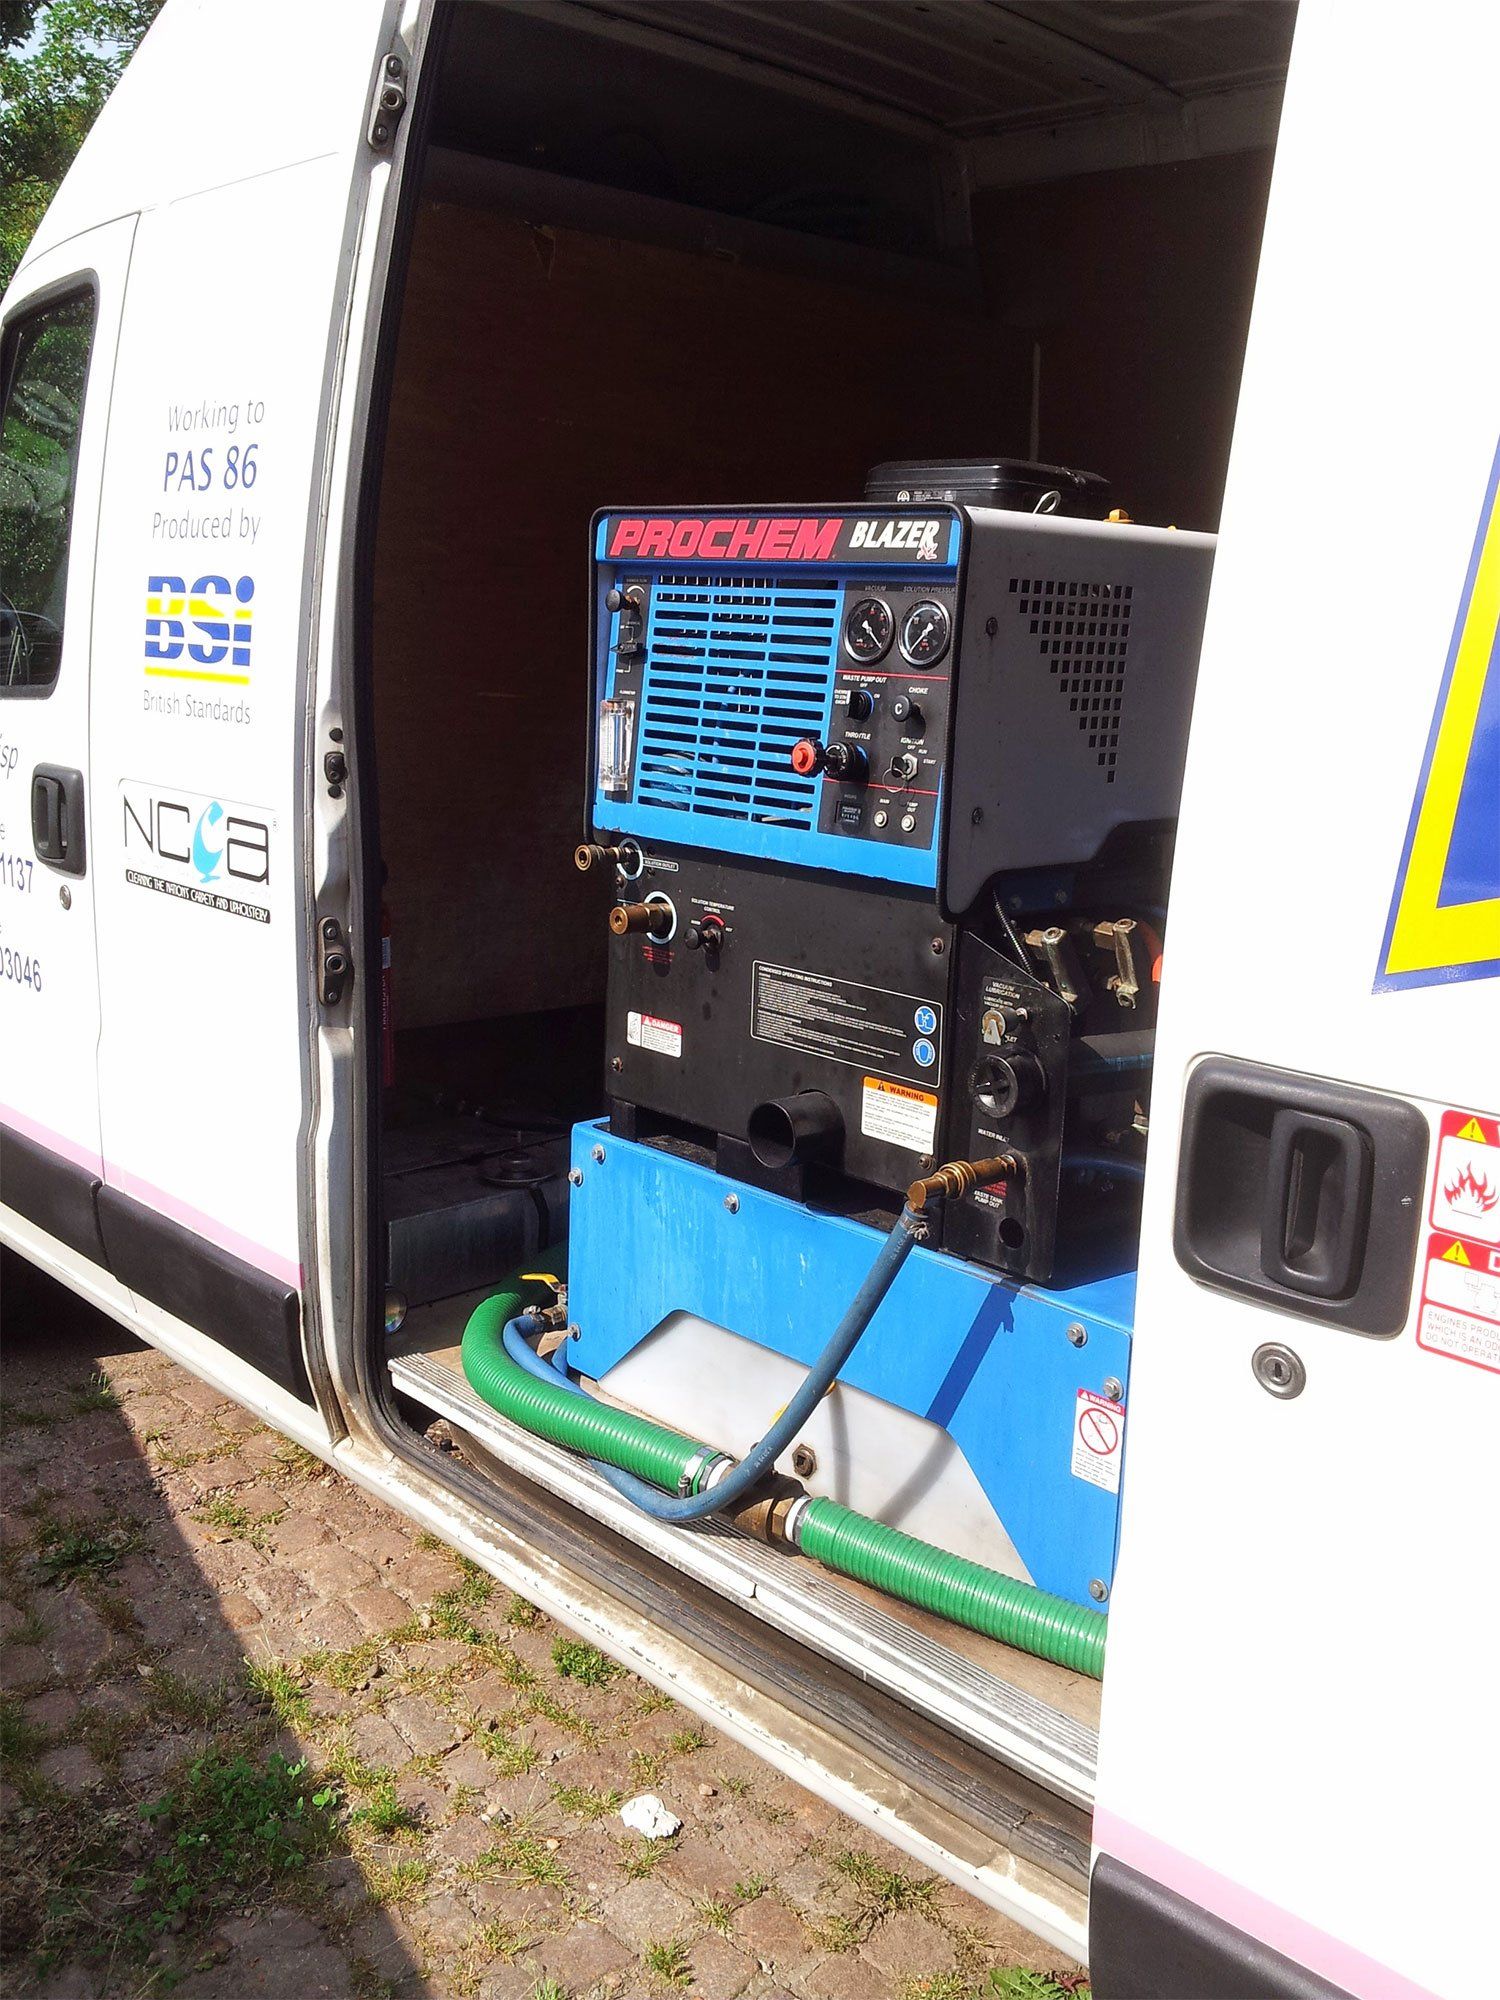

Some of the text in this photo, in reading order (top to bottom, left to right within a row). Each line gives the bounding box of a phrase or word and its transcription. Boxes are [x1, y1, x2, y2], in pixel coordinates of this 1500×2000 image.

[168, 400, 264, 434] Working to
[164, 444, 258, 491] PAS 86
[152, 508, 260, 545] Produced by
[609, 518, 940, 559] PROCHEM BLAZER
[842, 674, 860, 682] WASTE
[860, 675, 876, 683] PUMP
[908, 686, 929, 694] CHOKE
[143, 690, 251, 724] British Standards
[844, 731, 871, 740] THROTTLE
[0, 744, 18, 779] sp
[154, 878, 165, 892] THE
[190, 889, 215, 907] CARPETS
[217, 897, 229, 910] AND
[230, 901, 269, 922] UPHOLSTERY
[985, 986, 1020, 999] LUBRICATION
[992, 981, 1015, 991] VACUUM
[651, 1018, 680, 1034] DANGER
[889, 1086, 925, 1102] WARNING
[977, 1128, 996, 1139] WATER
[974, 1196, 1000, 1209] PUMP OUT
[989, 1194, 1004, 1205] TANK
[1428, 1311, 1467, 1330] ENGINES
[1427, 1321, 1456, 1337] WHICH
[1459, 1332, 1467, 1341] IS
[1470, 1335, 1481, 1346] AN
[1442, 1337, 1459, 1348] NOT
[1089, 1394, 1122, 1413] WARNING
